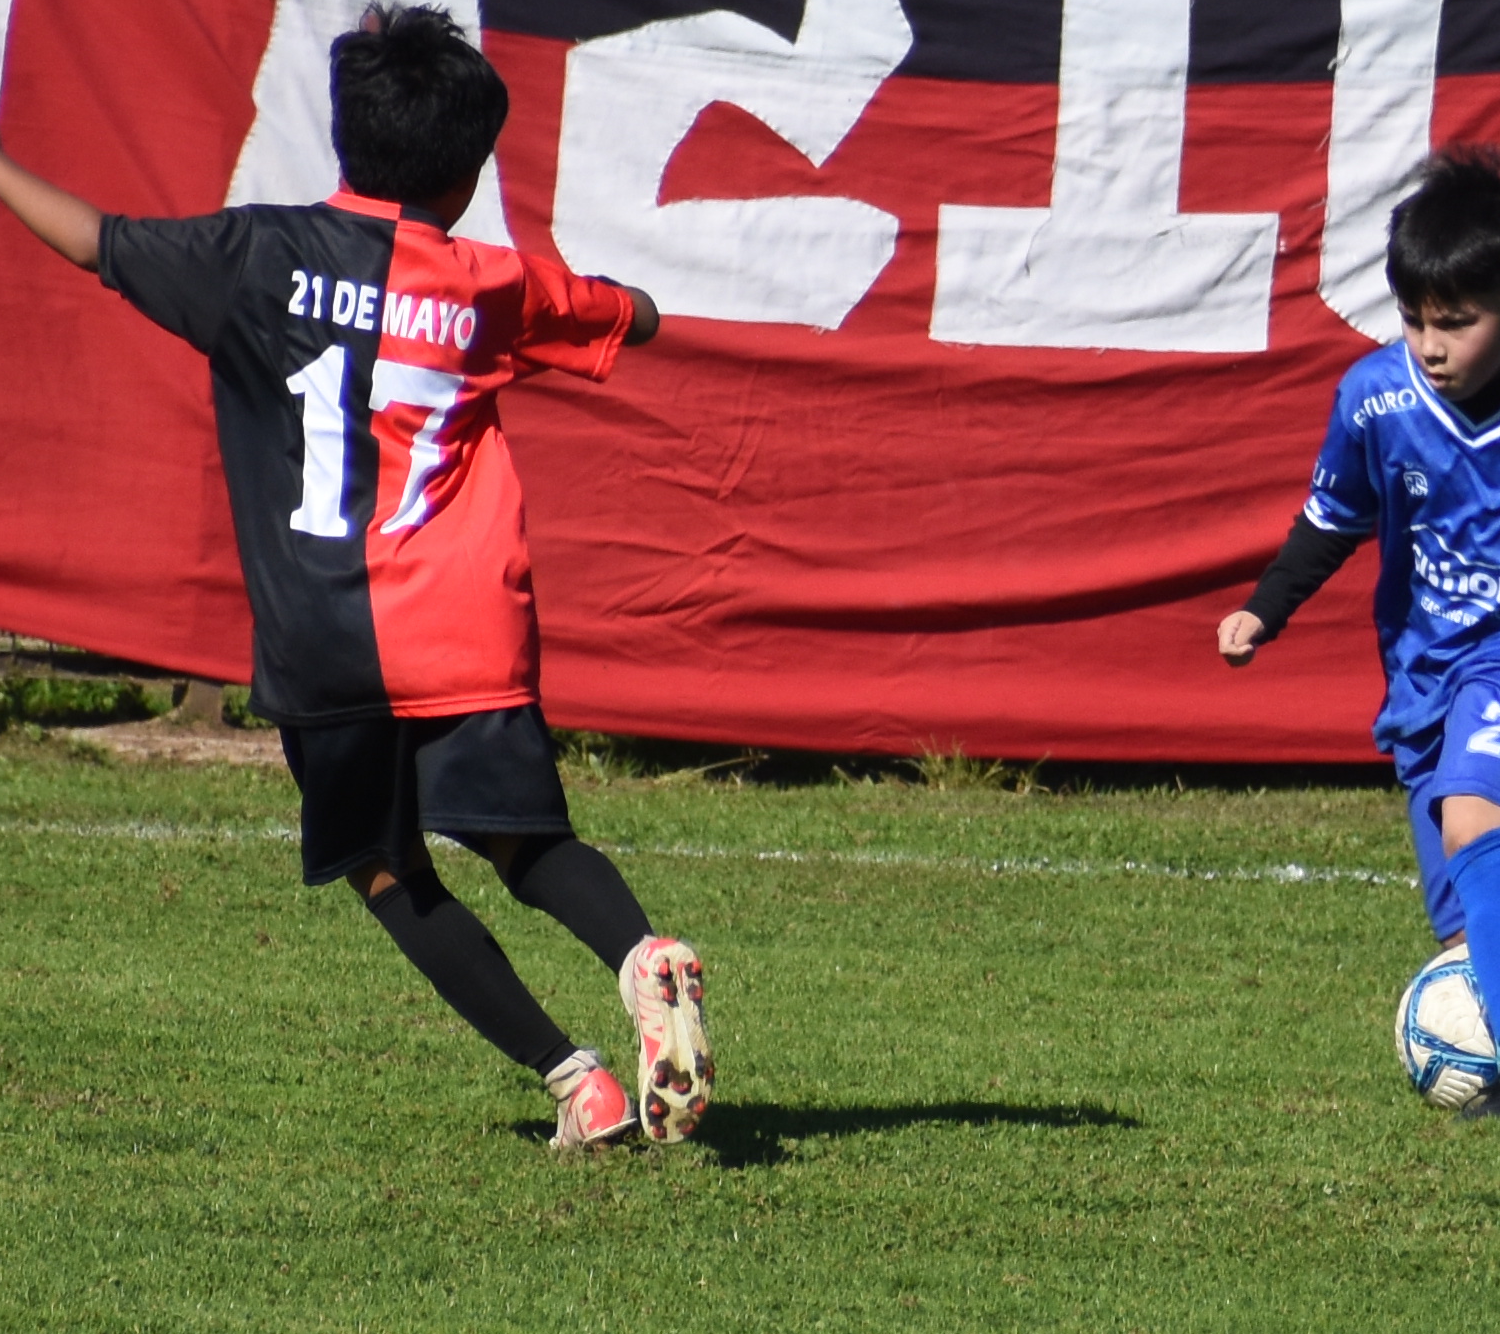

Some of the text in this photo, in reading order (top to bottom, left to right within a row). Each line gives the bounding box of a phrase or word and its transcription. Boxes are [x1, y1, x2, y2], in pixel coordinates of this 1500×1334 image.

[288, 270, 477, 351] 21 DE MAYO
[286, 344, 465, 538] 17
